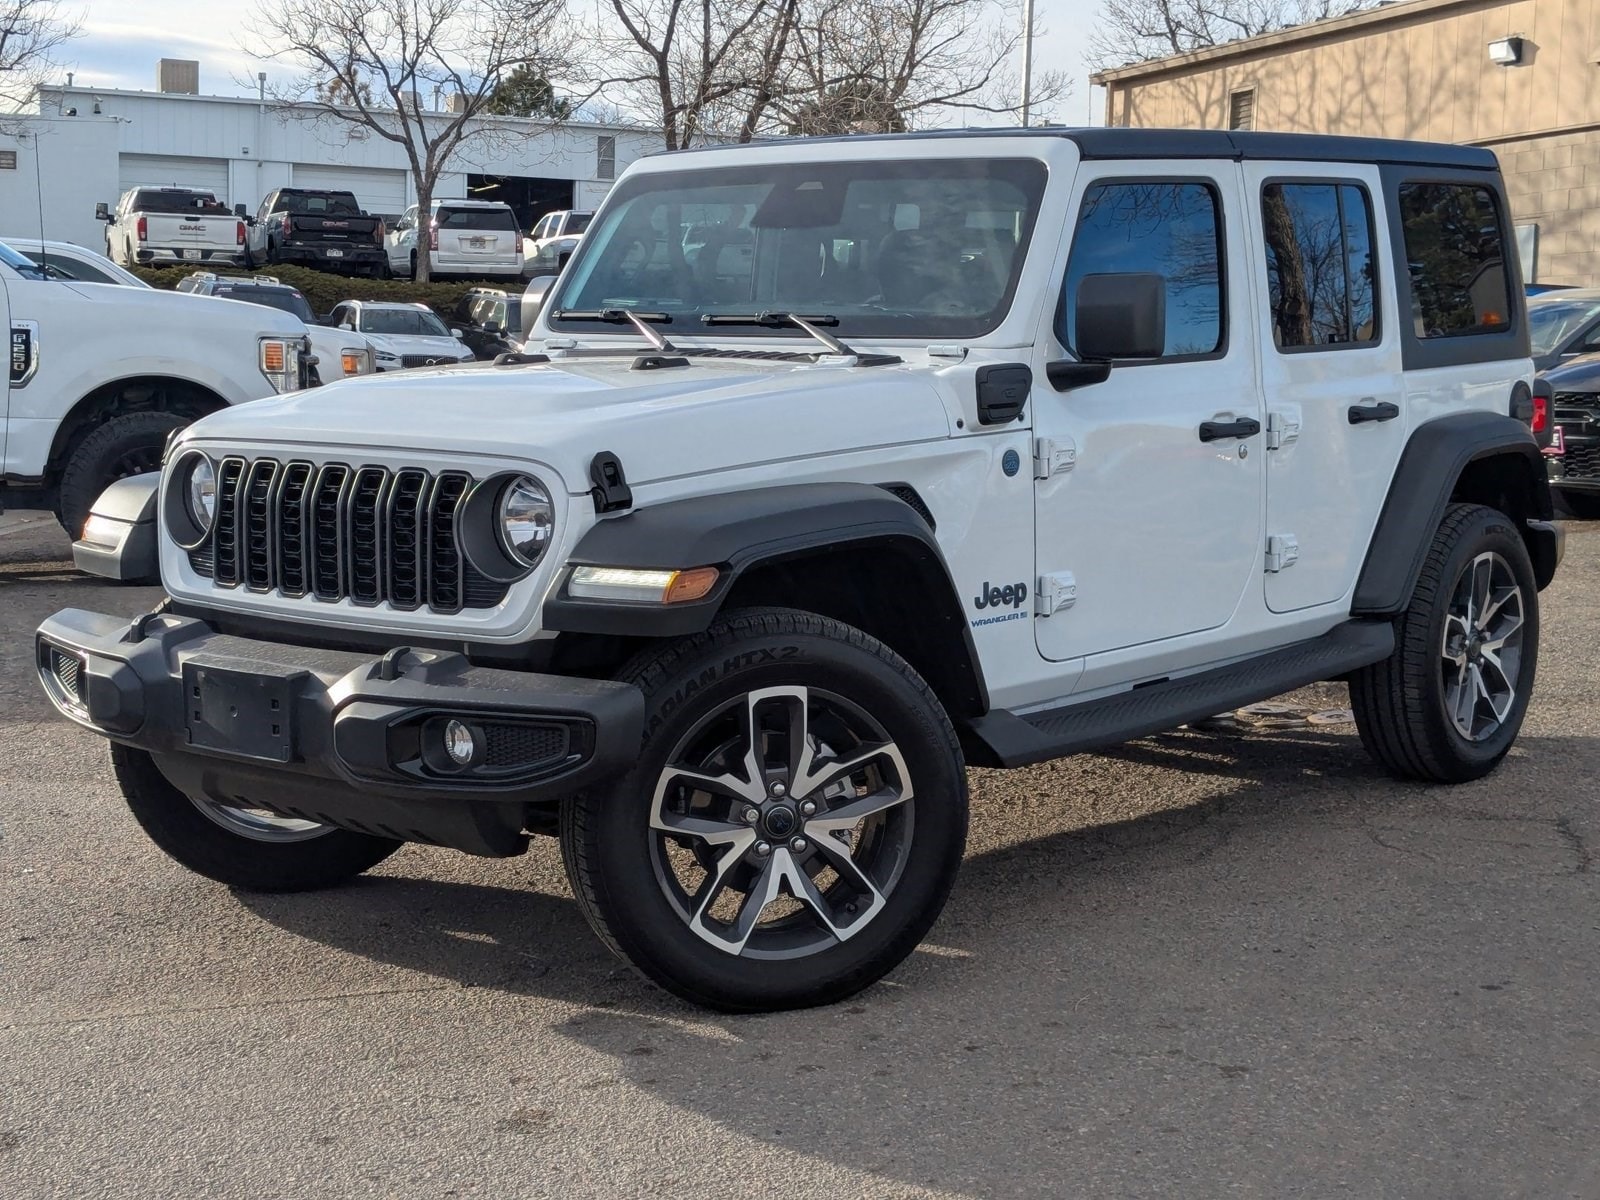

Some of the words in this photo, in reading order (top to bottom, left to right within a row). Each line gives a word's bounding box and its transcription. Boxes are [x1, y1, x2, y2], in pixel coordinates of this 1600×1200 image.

[179, 224, 207, 232] GMC
[322, 221, 349, 229] GMC
[974, 581, 1028, 610] Jeep
[971, 612, 1020, 628] WRANGLER
